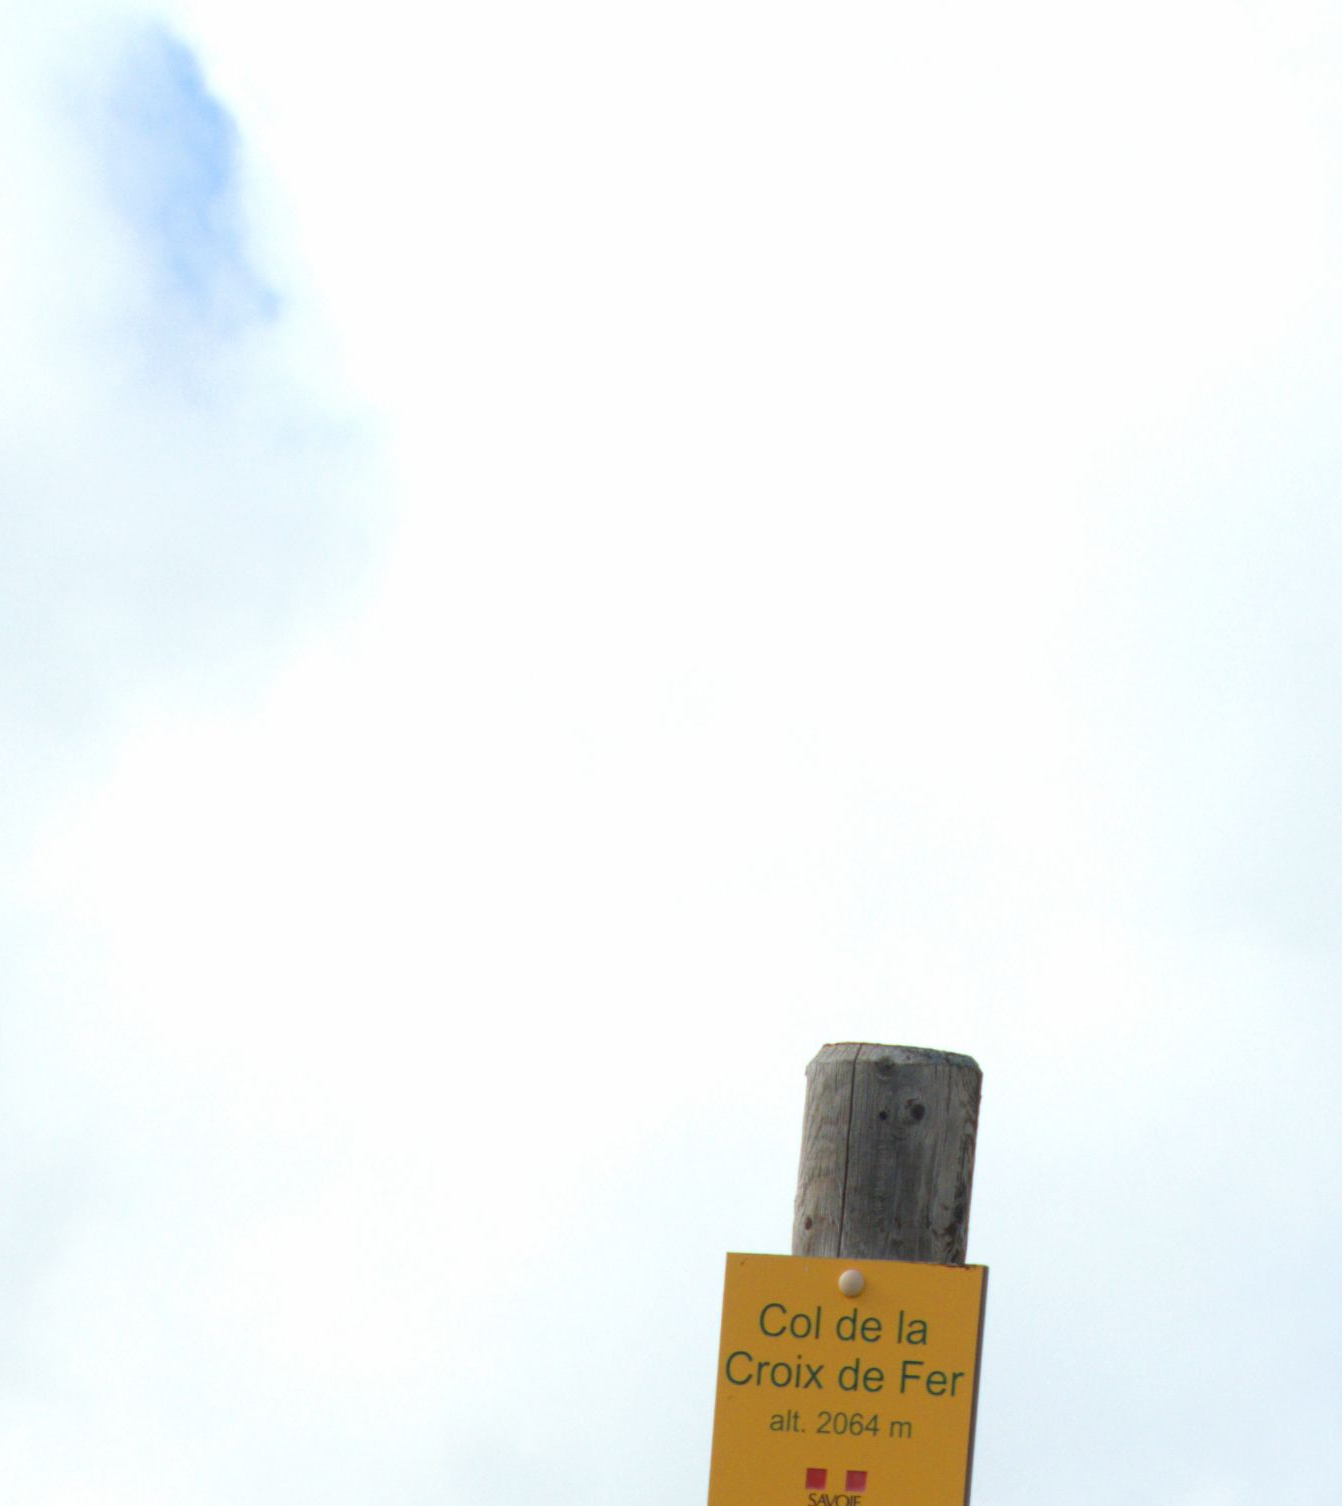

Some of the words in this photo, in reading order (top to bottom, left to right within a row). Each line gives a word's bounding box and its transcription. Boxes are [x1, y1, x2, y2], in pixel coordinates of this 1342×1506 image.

[760, 1304, 821, 1339] Col
[836, 1308, 882, 1342] de
[897, 1311, 928, 1345] la
[725, 1352, 824, 1389] Croix
[839, 1359, 883, 1392] de
[900, 1361, 963, 1397] Fer
[770, 1410, 805, 1432] alt.
[817, 1411, 880, 1436] 2064
[890, 1420, 911, 1438] m
